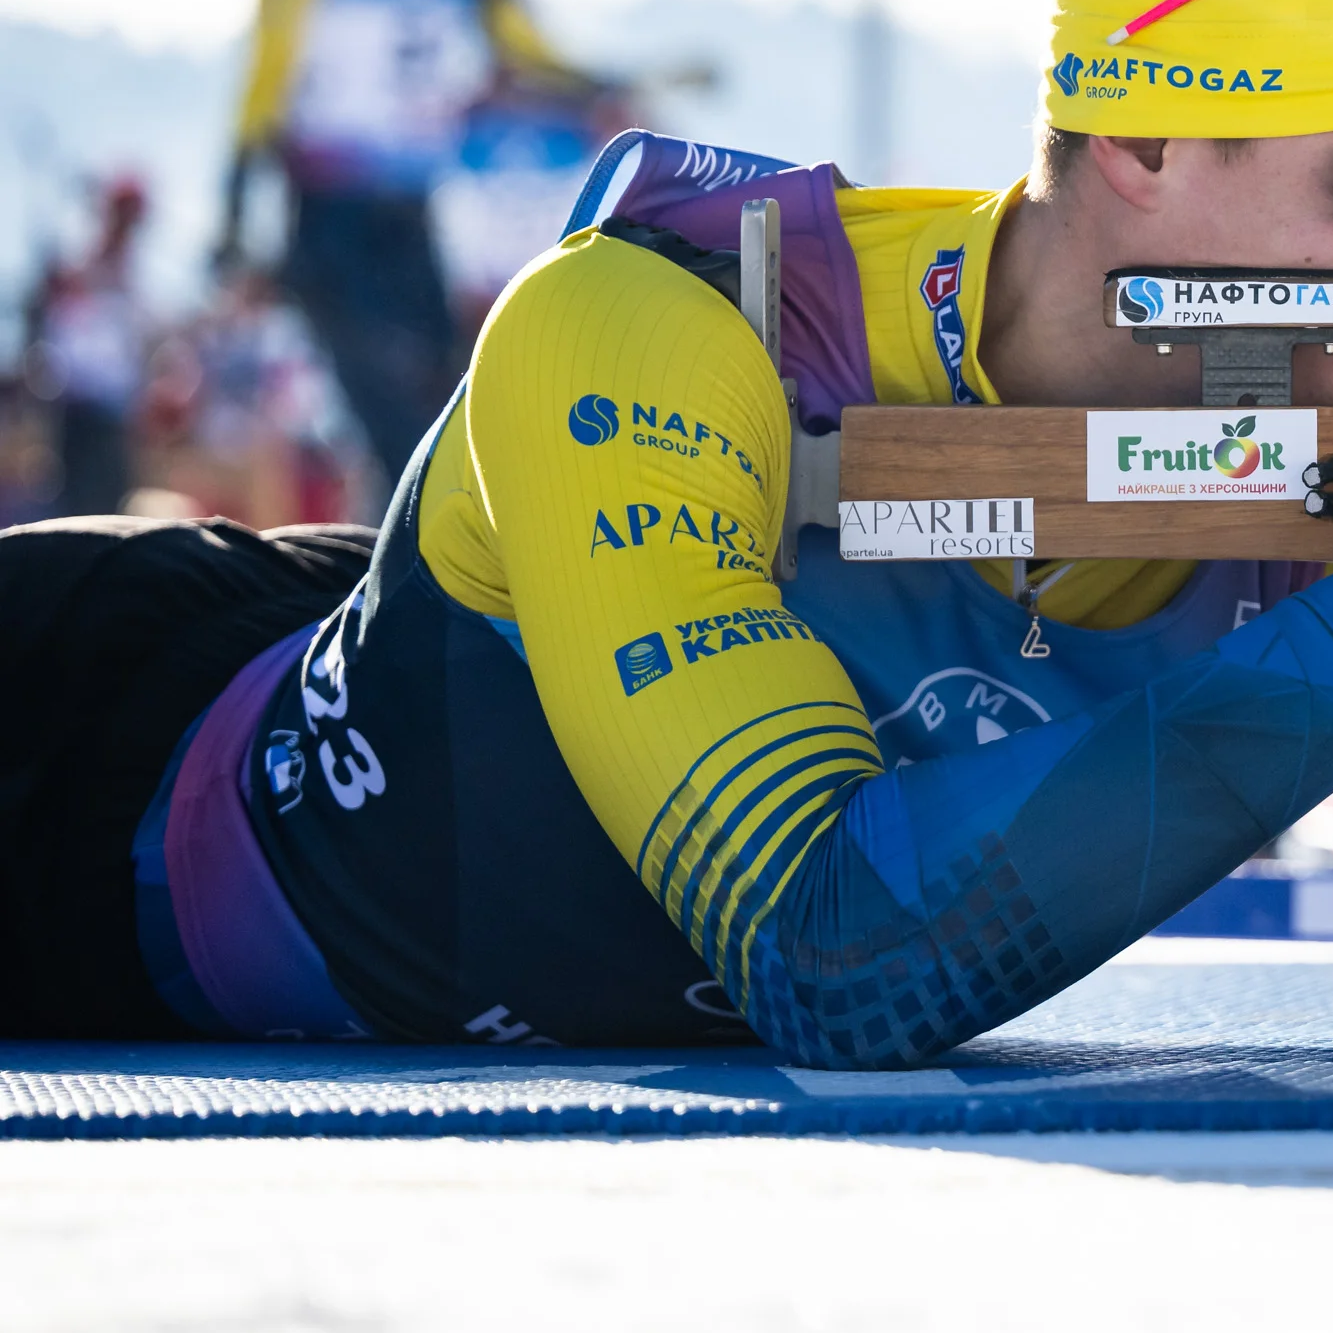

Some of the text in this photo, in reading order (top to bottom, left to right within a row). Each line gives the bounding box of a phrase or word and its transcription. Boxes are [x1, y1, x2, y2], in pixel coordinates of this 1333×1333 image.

[1084, 58, 1283, 92] NAFTOGAZ
[1086, 86, 1127, 100] GROUP
[1174, 311, 1224, 324] ГРУПА
[632, 433, 700, 458] GROUP
[1118, 482, 1186, 495] НАЙКРАЩЕ
[1200, 483, 1287, 495] ХЕРСОНЩИНИ
[841, 500, 1033, 534] APARTEL
[841, 548, 893, 558] apartel.ua
[930, 534, 1034, 555] resorts
[681, 621, 818, 664] КАПІТ
[632, 667, 663, 690] БАНК
[918, 682, 1010, 732] BM
